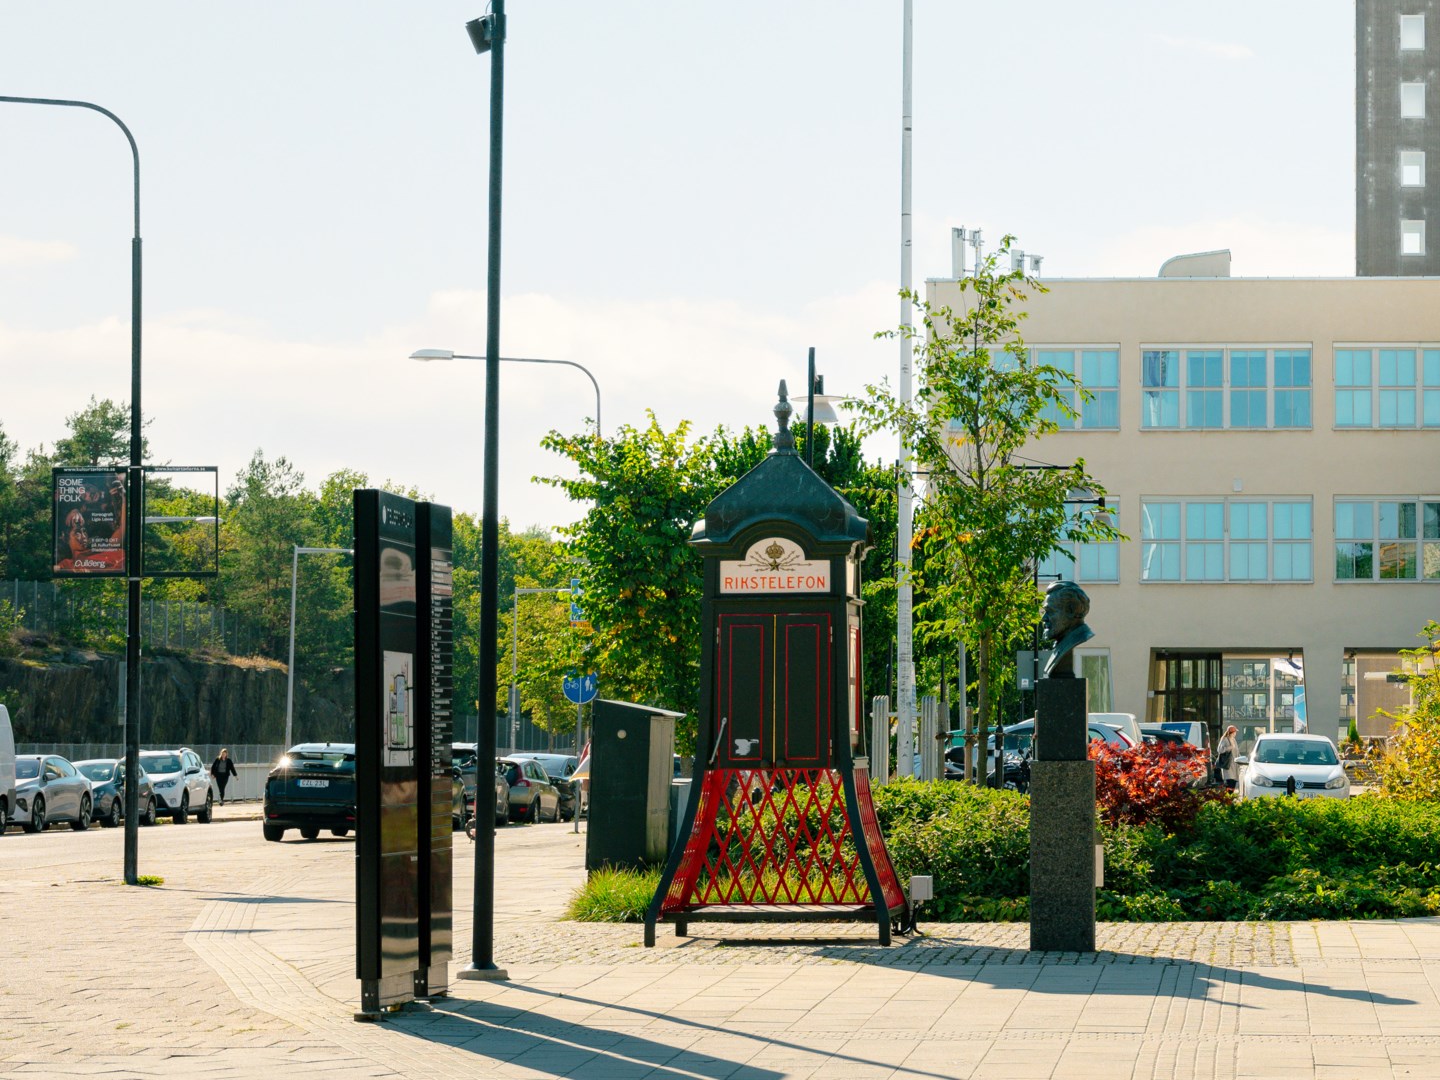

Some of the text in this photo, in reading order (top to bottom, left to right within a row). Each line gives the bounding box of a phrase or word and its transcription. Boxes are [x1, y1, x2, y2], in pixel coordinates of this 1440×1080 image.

[59, 478, 83, 487] SOME
[59, 494, 82, 503] FOLK
[724, 576, 826, 590] RIKSTELEFON
